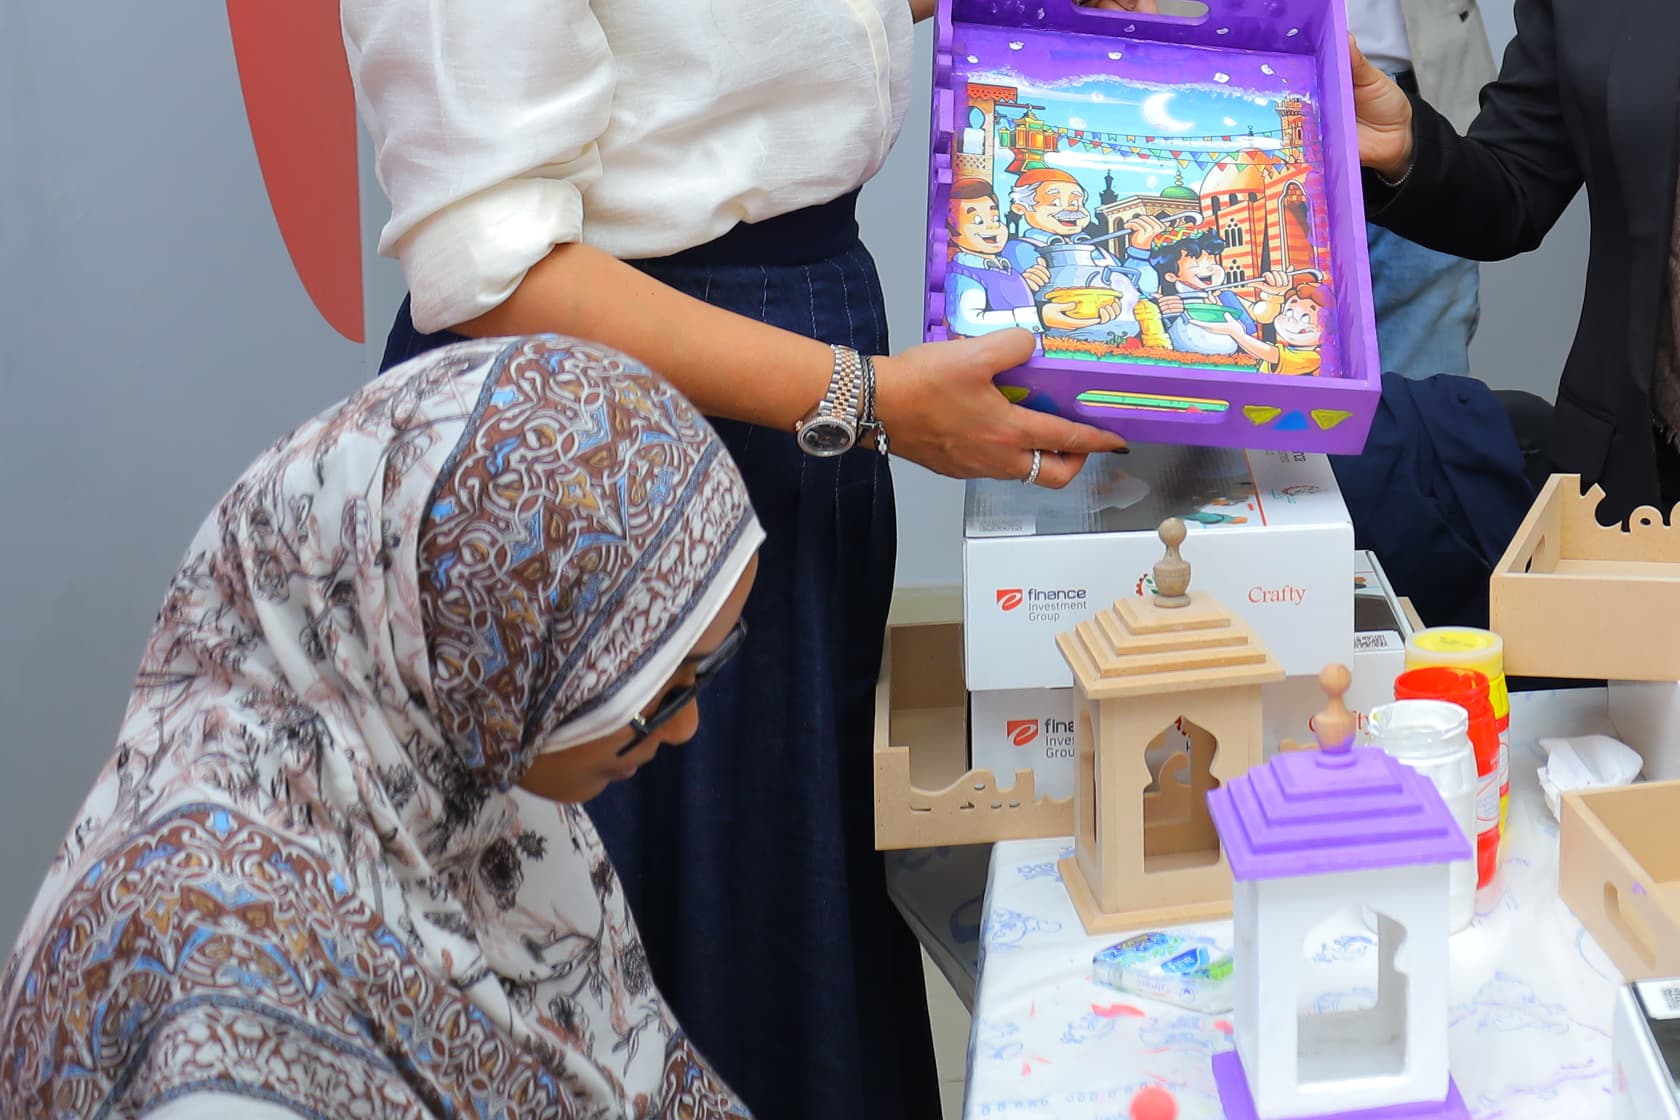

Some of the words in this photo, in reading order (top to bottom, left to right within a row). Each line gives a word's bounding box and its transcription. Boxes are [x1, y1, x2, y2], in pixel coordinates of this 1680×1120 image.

[1028, 588, 1087, 601] finance
[1248, 584, 1307, 606] Crafty
[1028, 600, 1088, 612] Investment
[1028, 612, 1060, 623] Group
[1046, 747, 1075, 758] Grou
